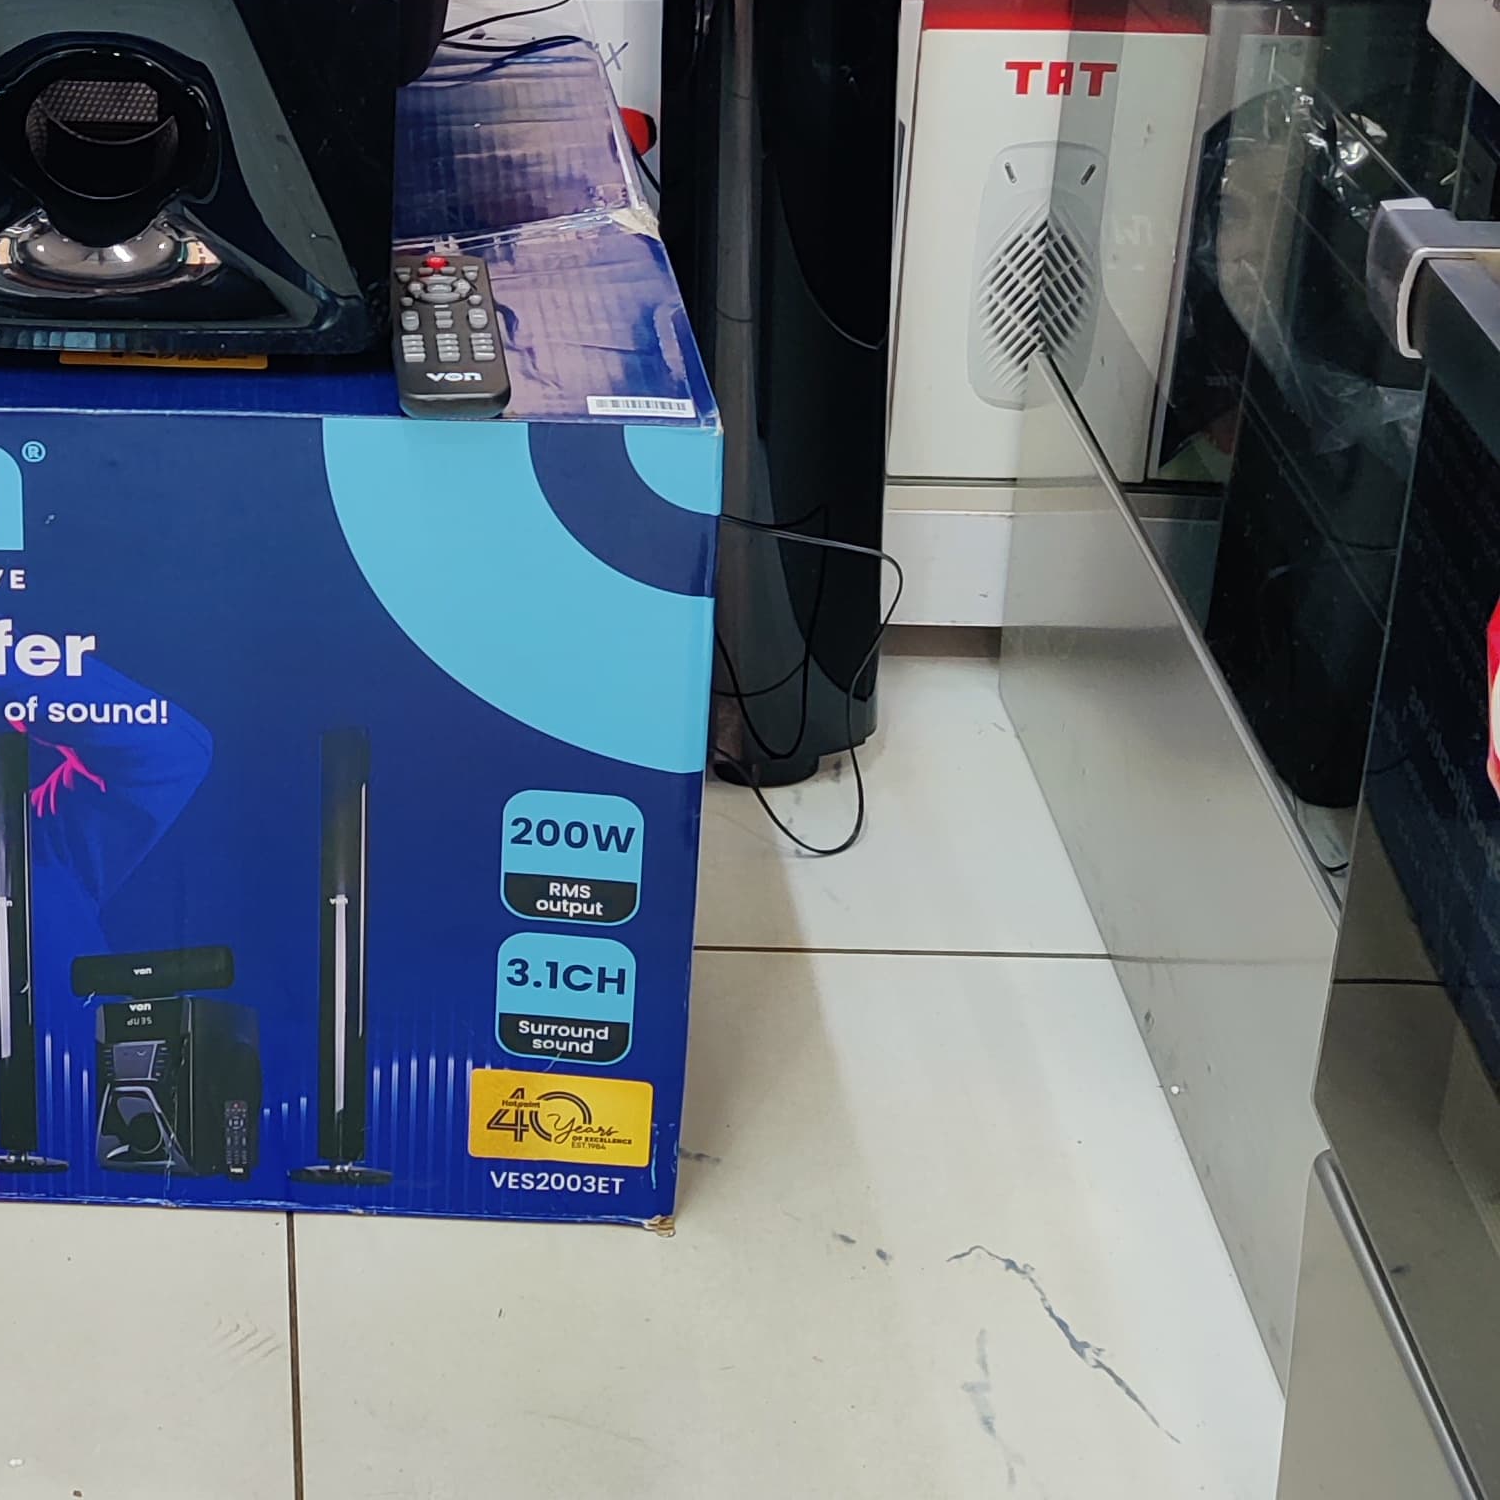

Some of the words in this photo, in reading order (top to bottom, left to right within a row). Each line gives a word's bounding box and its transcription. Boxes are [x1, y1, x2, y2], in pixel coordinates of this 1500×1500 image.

[3, 697, 38, 722] of
[48, 698, 169, 725] sound!
[510, 817, 636, 853] 200W
[549, 881, 591, 899] RMS
[536, 898, 604, 917] output
[506, 958, 627, 996] 3.1CH
[518, 1019, 609, 1041] Surround
[532, 1037, 594, 1055] sound
[547, 1113, 619, 1144] Years
[490, 1171, 625, 1195] VES2003ET
